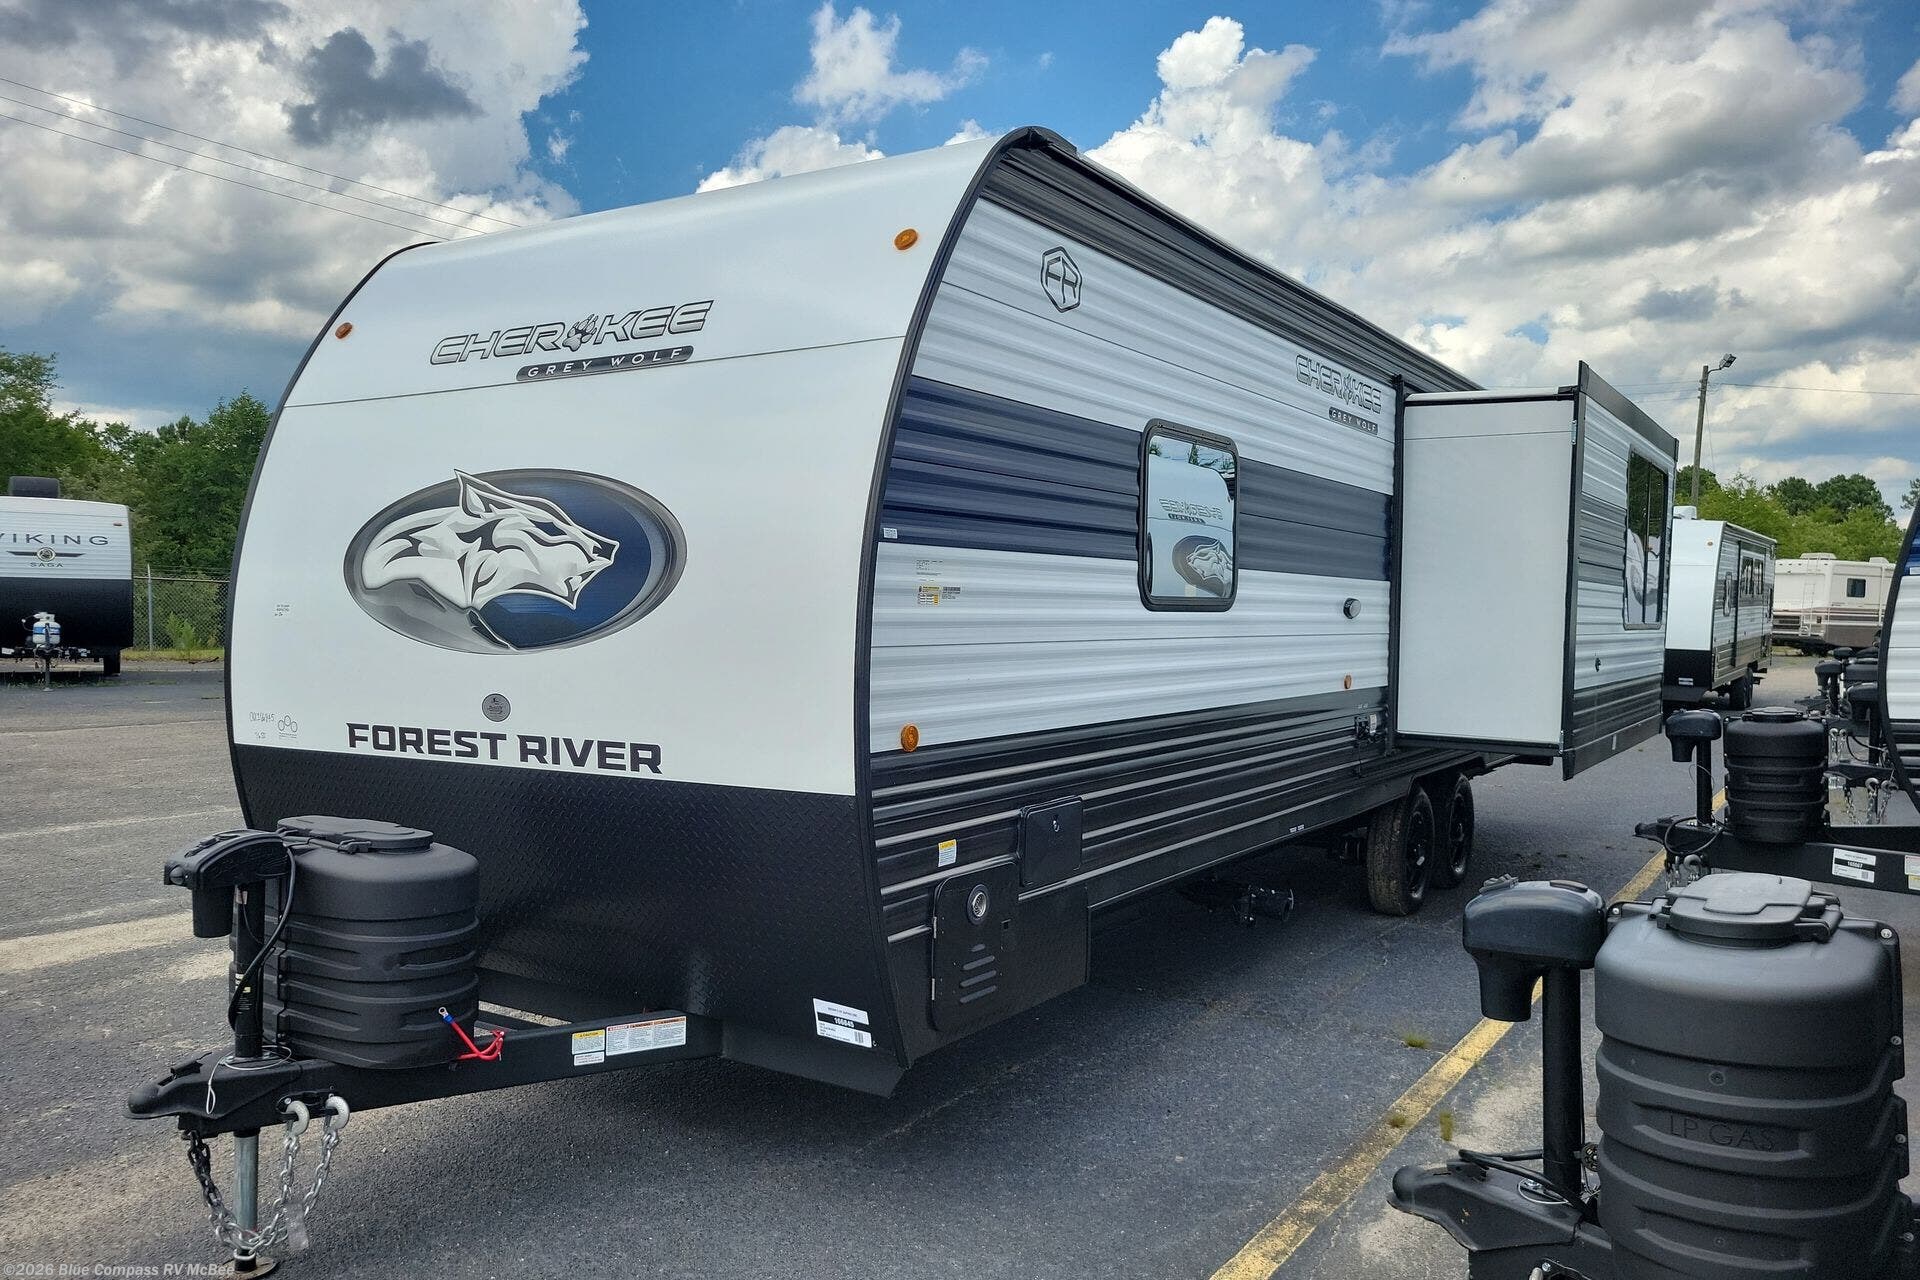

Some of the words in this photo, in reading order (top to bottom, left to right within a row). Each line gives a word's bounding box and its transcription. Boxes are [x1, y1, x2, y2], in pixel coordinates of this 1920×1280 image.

[430, 300, 714, 365] CHEROKEE
[527, 361, 594, 378] GREY
[610, 348, 683, 368] WOLF
[1331, 409, 1353, 424] GREY
[1355, 418, 1377, 431] WOLF
[346, 722, 507, 761] FOREST
[516, 734, 663, 775] RIVER
[1670, 1112, 1699, 1139] LP
[1709, 1122, 1776, 1152] GAS
